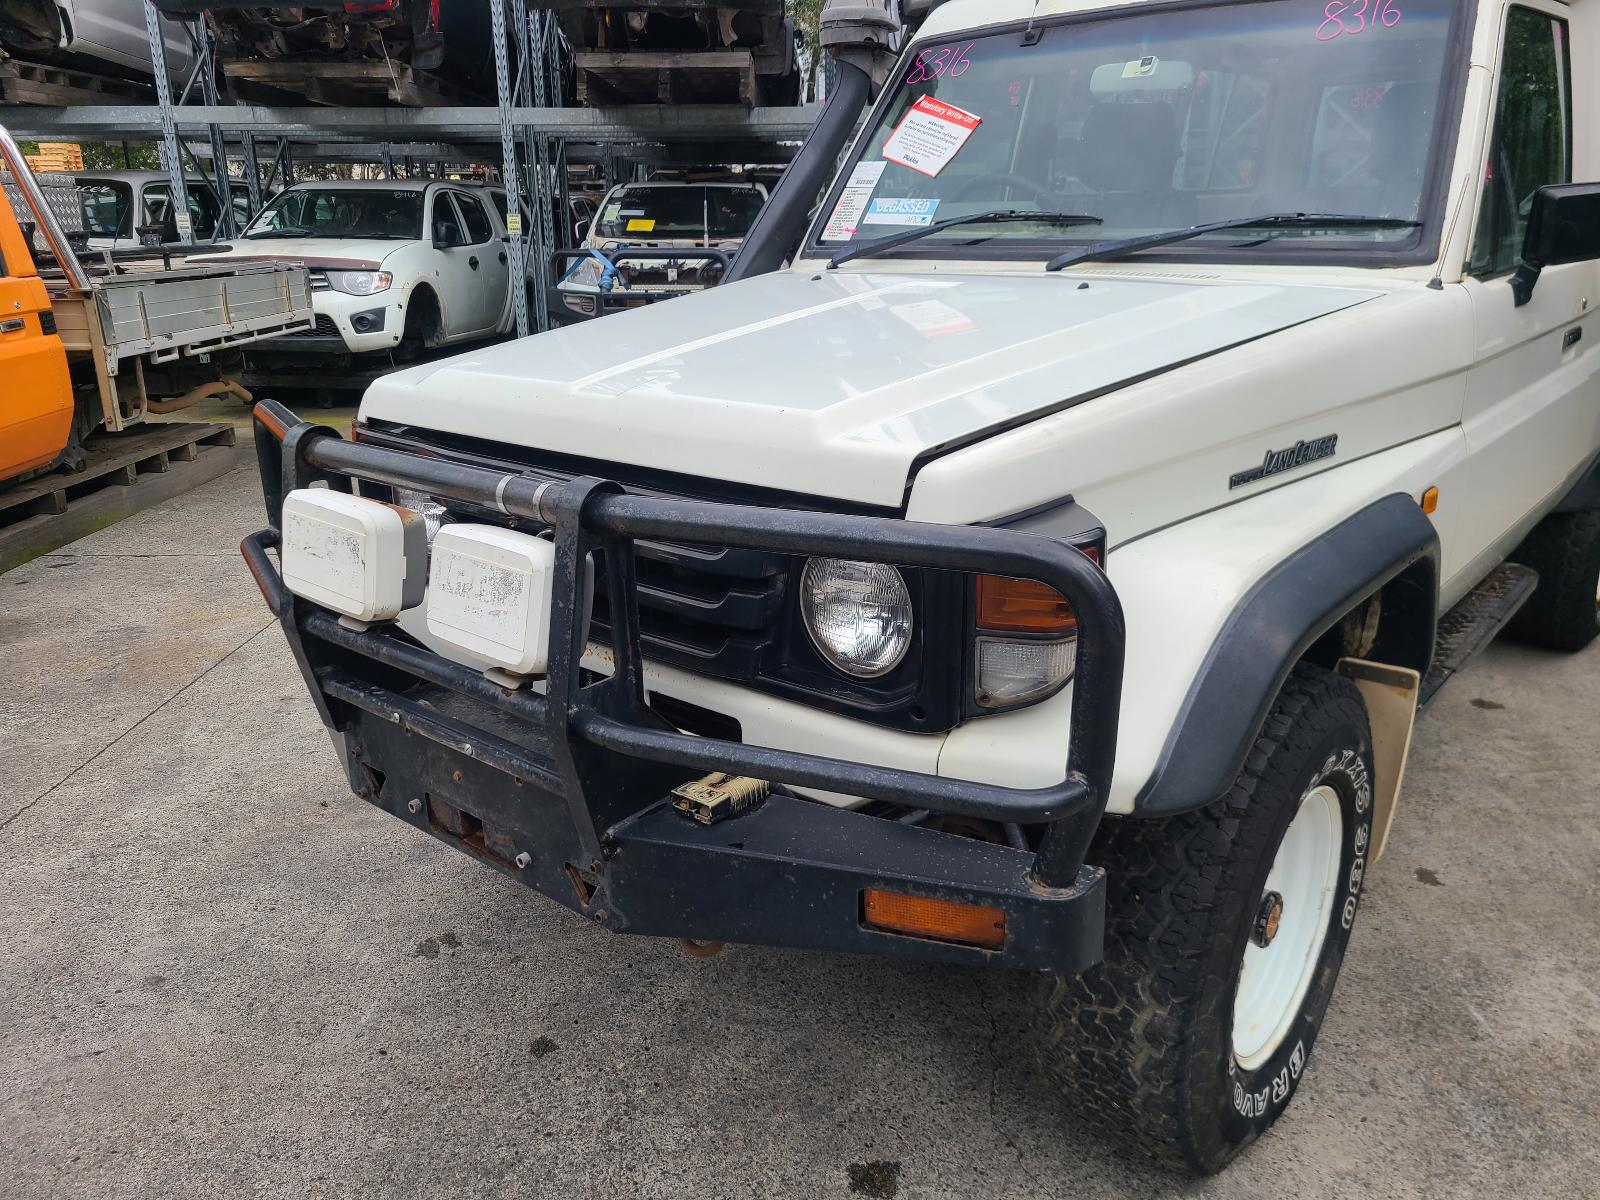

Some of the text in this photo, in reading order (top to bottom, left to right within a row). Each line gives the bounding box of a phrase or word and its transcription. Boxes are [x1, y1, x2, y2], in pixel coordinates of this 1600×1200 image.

[1315, 0, 1401, 41] 8316
[906, 40, 976, 85] 8316
[919, 100, 975, 124] Statutory Write-Off
[1341, 822, 1369, 930] 980
[1233, 1039, 1305, 1119] BRAVO
